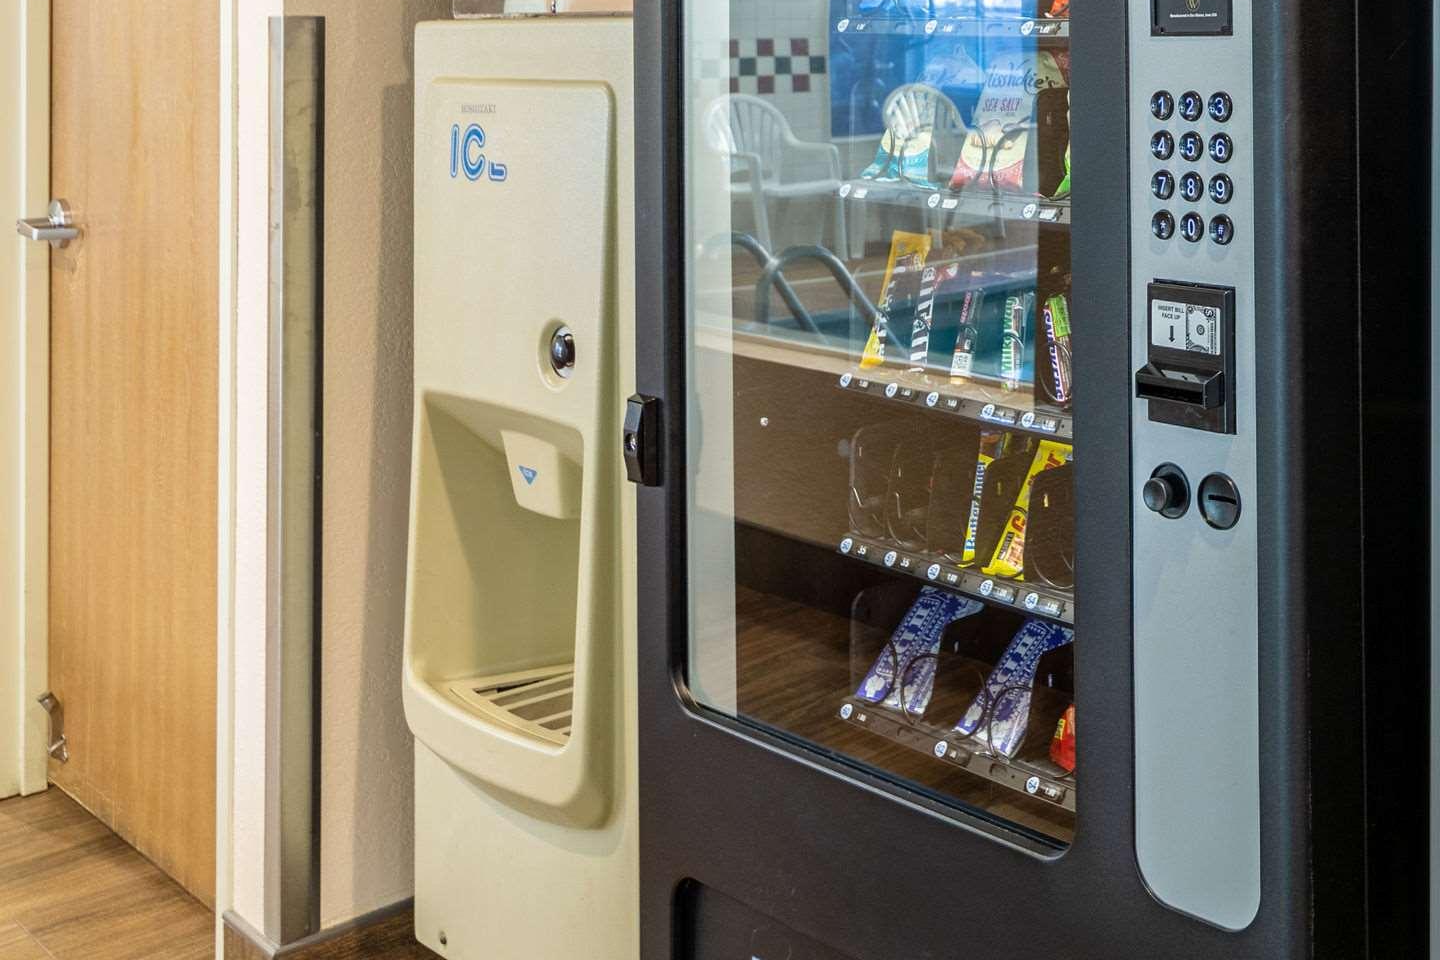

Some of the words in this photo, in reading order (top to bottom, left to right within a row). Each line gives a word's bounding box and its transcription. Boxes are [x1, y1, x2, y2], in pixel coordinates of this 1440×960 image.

[983, 97, 999, 113] SEA
[1001, 96, 1024, 112] SALT
[1158, 96, 1165, 115] 1
[1186, 97, 1194, 115] 2
[1215, 97, 1225, 116] 3
[1157, 137, 1165, 155] 4
[1187, 138, 1195, 156] 5
[1215, 138, 1225, 157] 6
[1158, 176, 1166, 194] 7
[1187, 178, 1195, 197] 8
[1216, 179, 1225, 198] 9
[1187, 218, 1196, 236] 0
